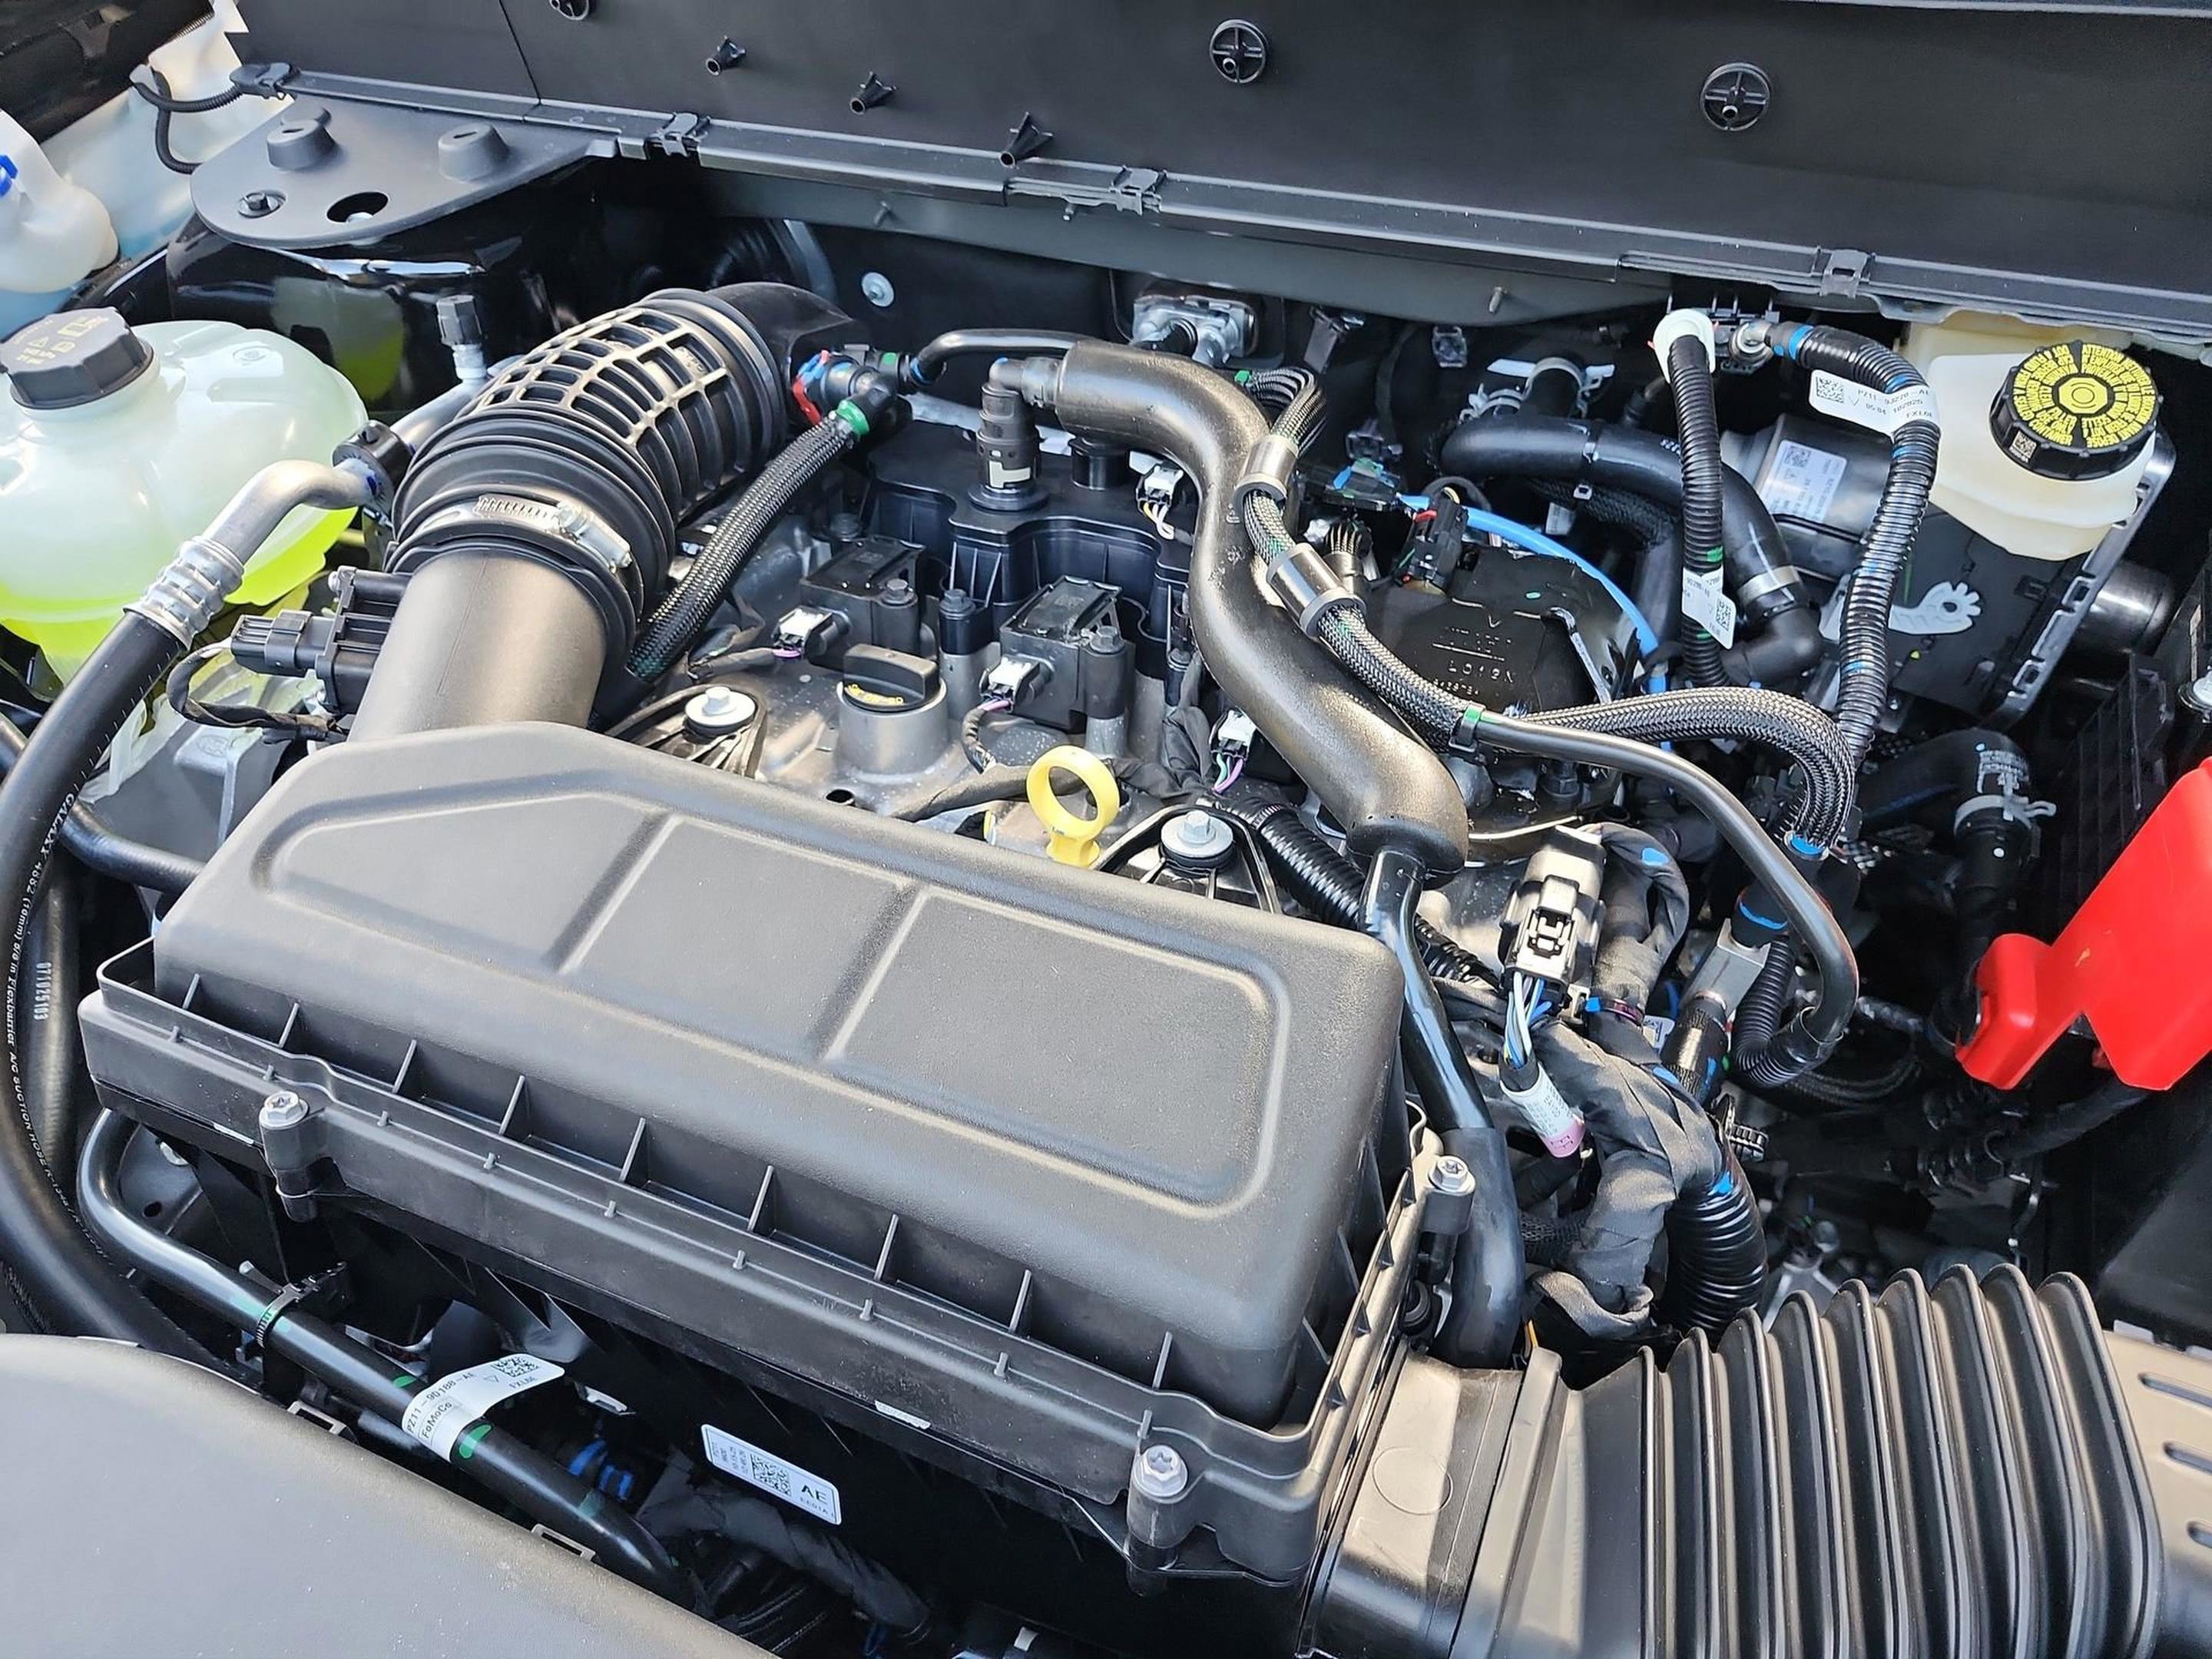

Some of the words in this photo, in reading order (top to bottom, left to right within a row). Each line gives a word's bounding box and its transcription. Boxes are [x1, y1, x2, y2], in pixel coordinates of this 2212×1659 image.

[2052, 345, 2069, 356] DOT
[2056, 353, 2074, 366] CAP
[2082, 344, 2124, 363] ATTENTION
[2014, 369, 2032, 388] FROM
[2031, 359, 2058, 381] BEFORE
[2141, 386, 2154, 395] LE
[2014, 396, 2035, 420] SEALED
[2036, 410, 2053, 425] USE
[2029, 419, 2072, 445] CONTAINER
[2048, 421, 2073, 436] ONLY
[2091, 427, 2108, 439] DOT
[2118, 421, 2142, 440] AVANT
[41, 793, 75, 859] GALAXY
[9, 962, 20, 974] in
[6, 976, 17, 1047] Flexbarrier
[9, 1051, 19, 1074] A/C
[12, 1076, 33, 1131] SUCTION
[28, 1133, 48, 1167] HOSE
[422, 1402, 453, 1439] FoMoCo
[801, 1484, 828, 1505] AE
